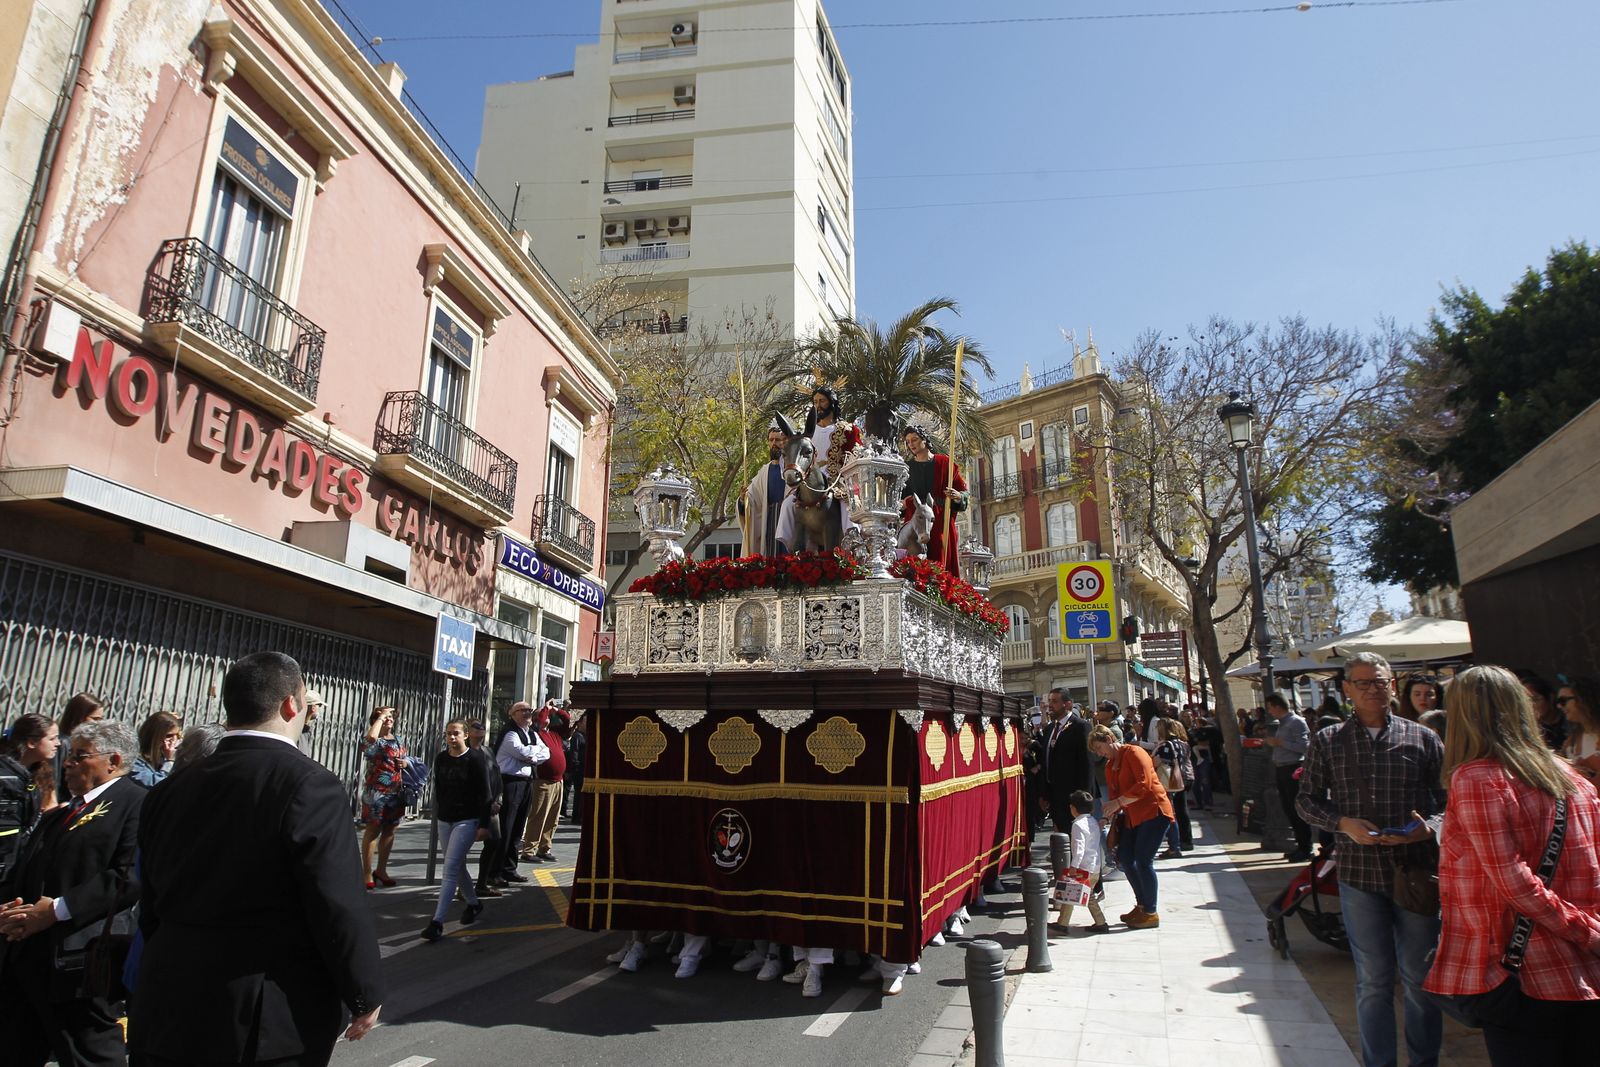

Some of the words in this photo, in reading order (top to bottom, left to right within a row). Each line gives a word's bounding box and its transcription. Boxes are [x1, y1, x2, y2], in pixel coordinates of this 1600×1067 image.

[66, 327, 364, 514] NOVEDADES
[383, 489, 485, 568] CARLOS
[508, 543, 540, 575] ECO
[553, 568, 599, 606] ORBERA
[1074, 577, 1097, 591] 30
[1064, 602, 1109, 611] CICLOCALLE
[441, 633, 472, 660] TAXI
[1543, 832, 1561, 866] LOLA
